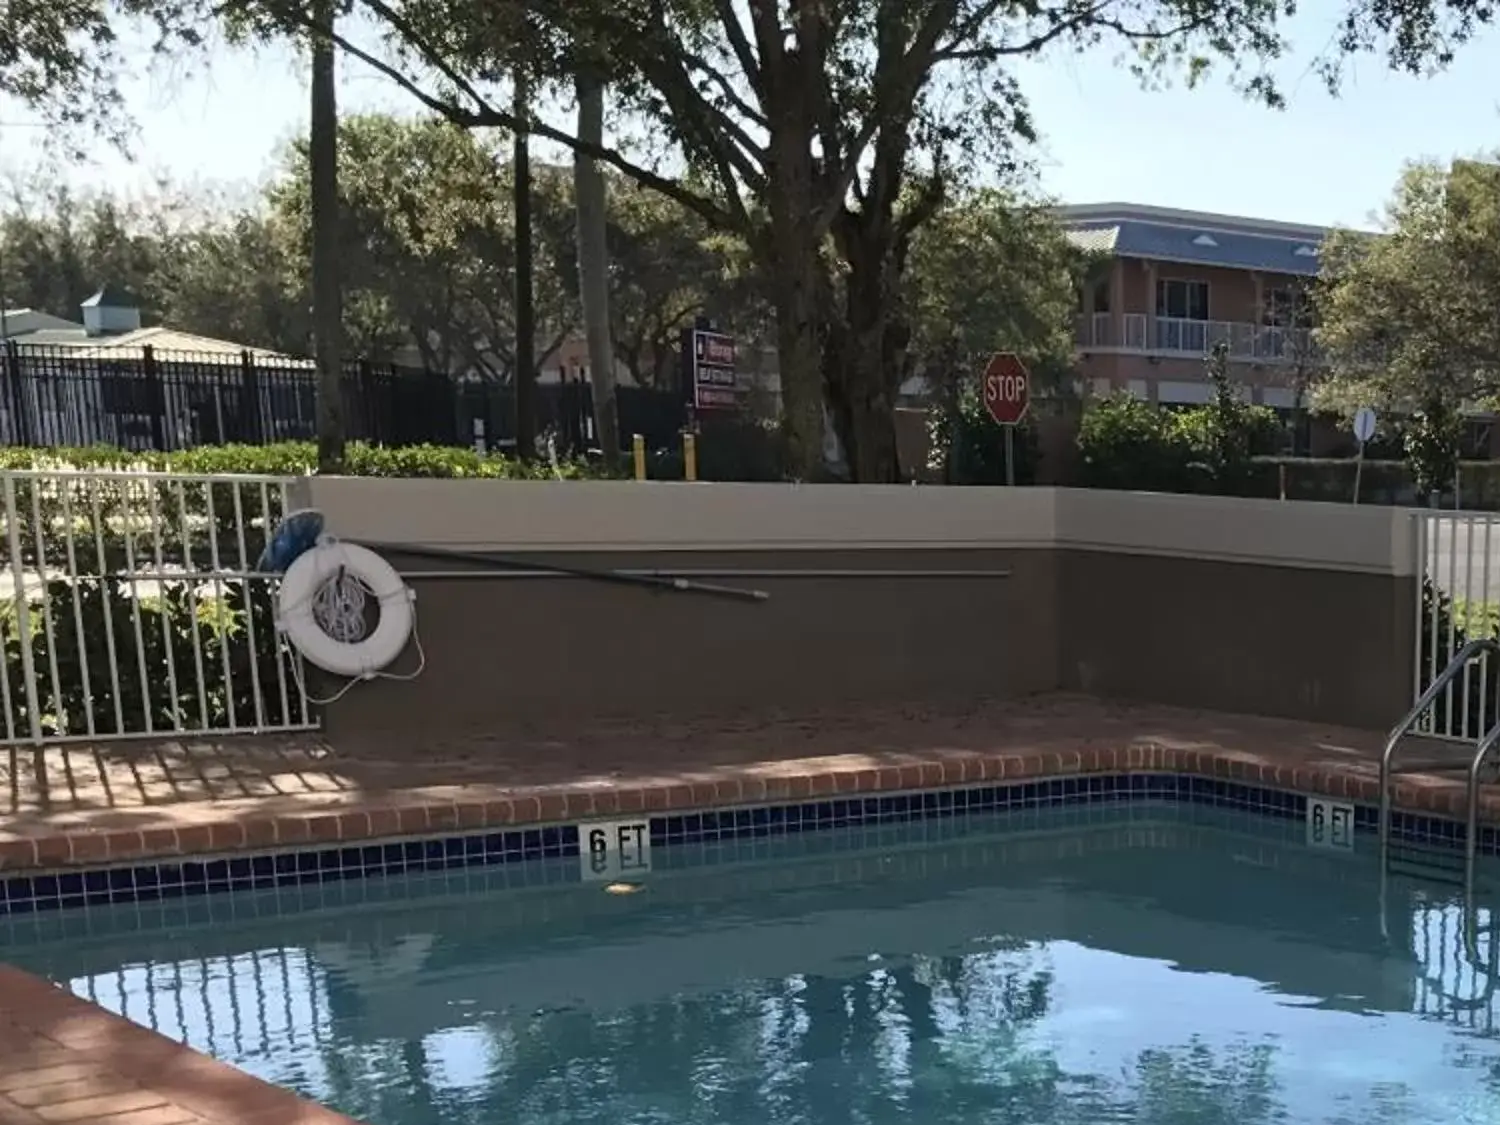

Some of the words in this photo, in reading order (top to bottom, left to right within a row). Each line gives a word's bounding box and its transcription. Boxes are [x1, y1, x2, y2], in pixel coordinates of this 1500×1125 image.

[987, 375, 1025, 401] STOP
[1313, 803, 1325, 825] 6
[1332, 806, 1353, 827] FT
[589, 829, 606, 852] 6
[618, 824, 647, 851] FT
